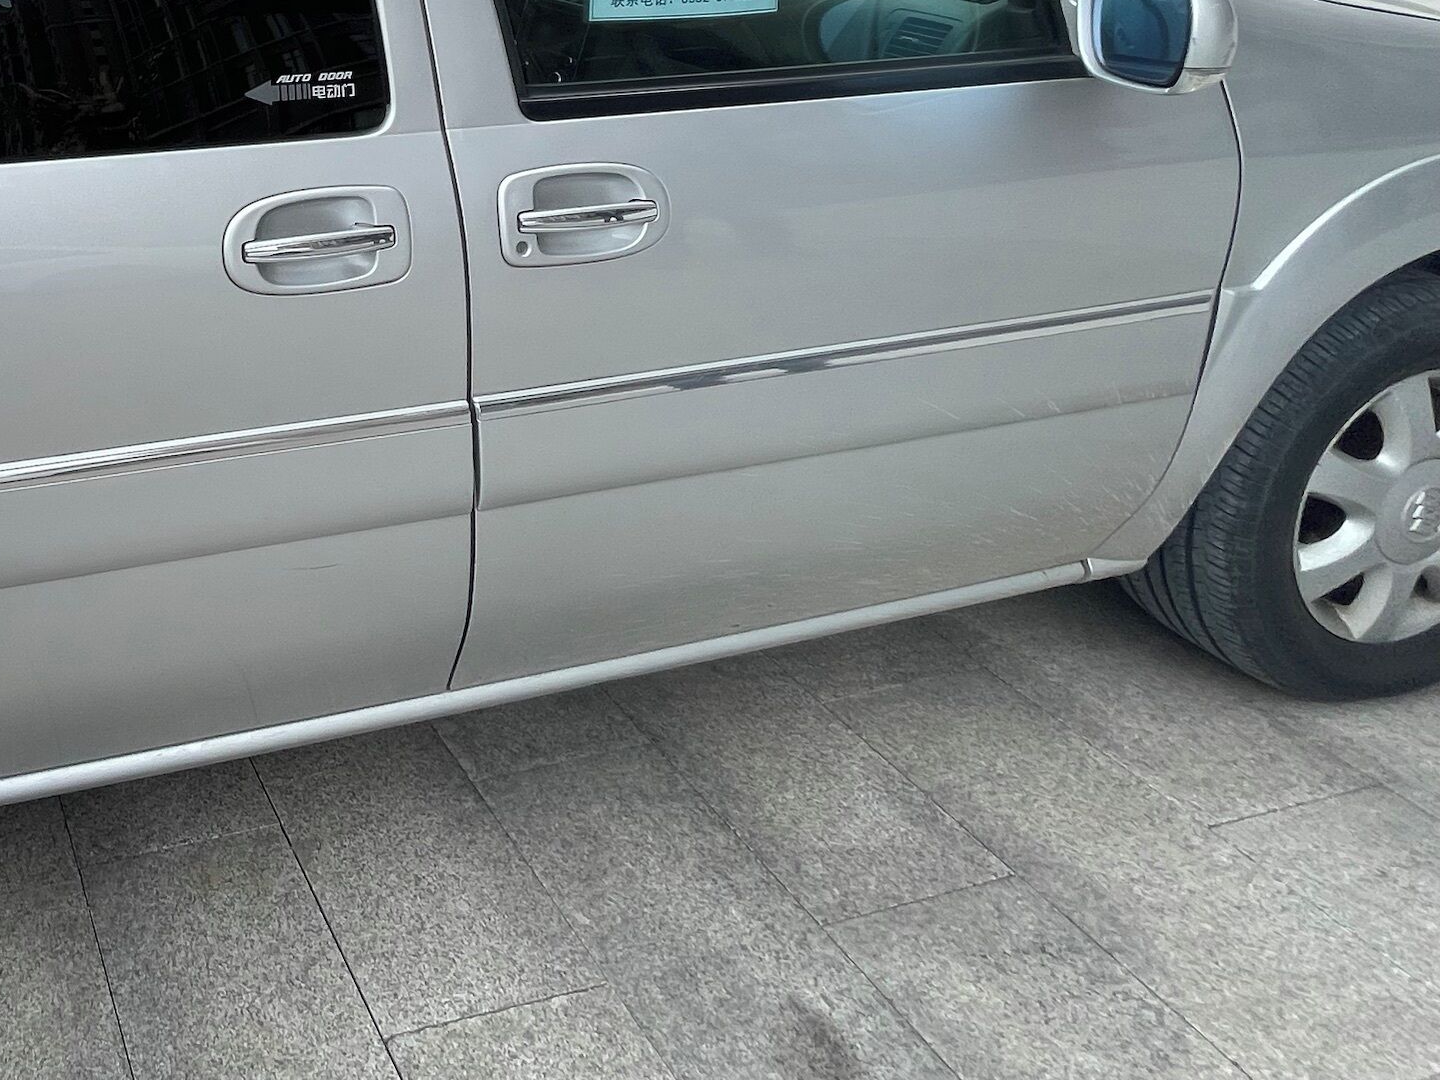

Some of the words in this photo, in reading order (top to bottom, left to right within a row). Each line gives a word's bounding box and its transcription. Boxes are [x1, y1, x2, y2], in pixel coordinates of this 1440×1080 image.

[276, 73, 311, 83] AUTO
[318, 71, 352, 81] DOOR
[312, 83, 355, 98] 电动门
